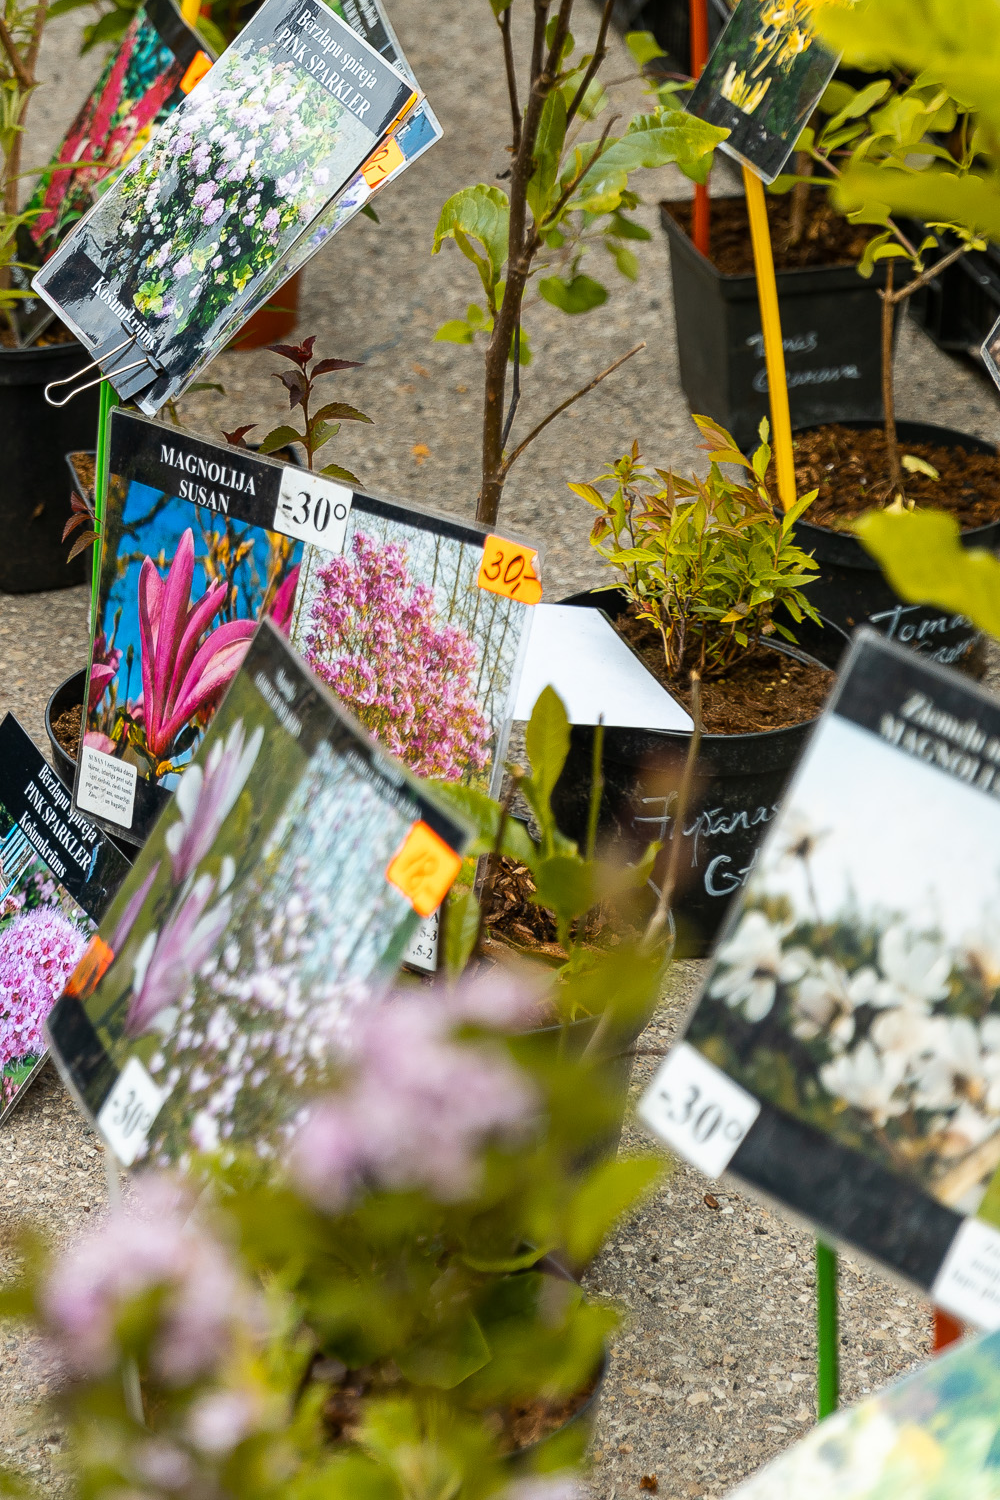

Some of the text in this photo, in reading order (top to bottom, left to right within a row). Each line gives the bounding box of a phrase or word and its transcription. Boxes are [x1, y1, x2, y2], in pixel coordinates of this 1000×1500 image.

[276, 27, 372, 120] PINK SPARKLER
[296, 8, 344, 59] Bērzlapu
[339, 52, 378, 90] spireja
[160, 444, 256, 496] MAGNOLIJA
[179, 480, 230, 514] SUSAN
[282, 491, 347, 532] -30°
[38, 763, 71, 811] Bērzlapu
[18, 810, 67, 878] Košumkrūms
[23, 780, 93, 871] PINK SPARKLER
